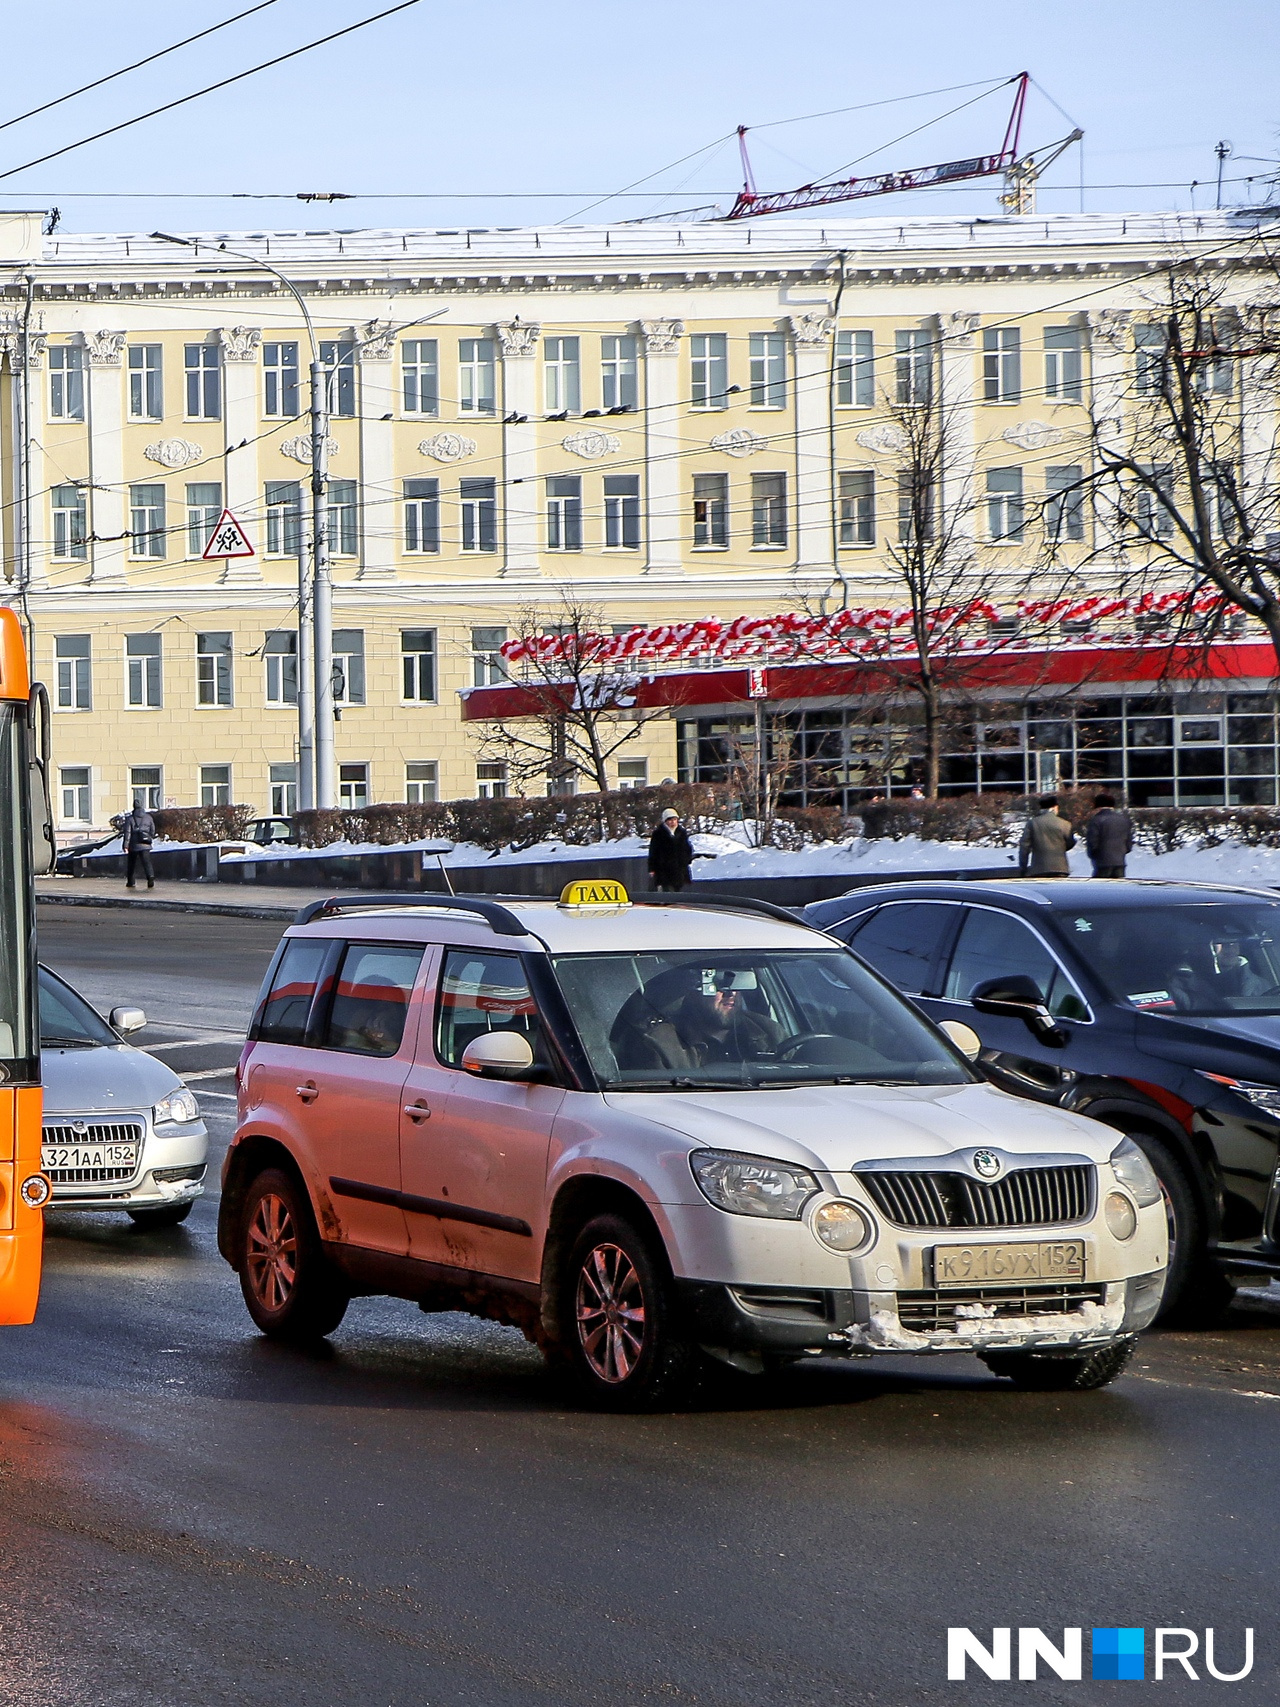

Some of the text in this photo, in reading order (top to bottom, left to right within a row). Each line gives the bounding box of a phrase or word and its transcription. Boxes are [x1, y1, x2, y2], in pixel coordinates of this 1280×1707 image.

[576, 885, 620, 902] TAXI
[106, 1146, 131, 1160] 152
[1043, 1244, 1078, 1266] 152
[1050, 1265, 1067, 1274] RUS
